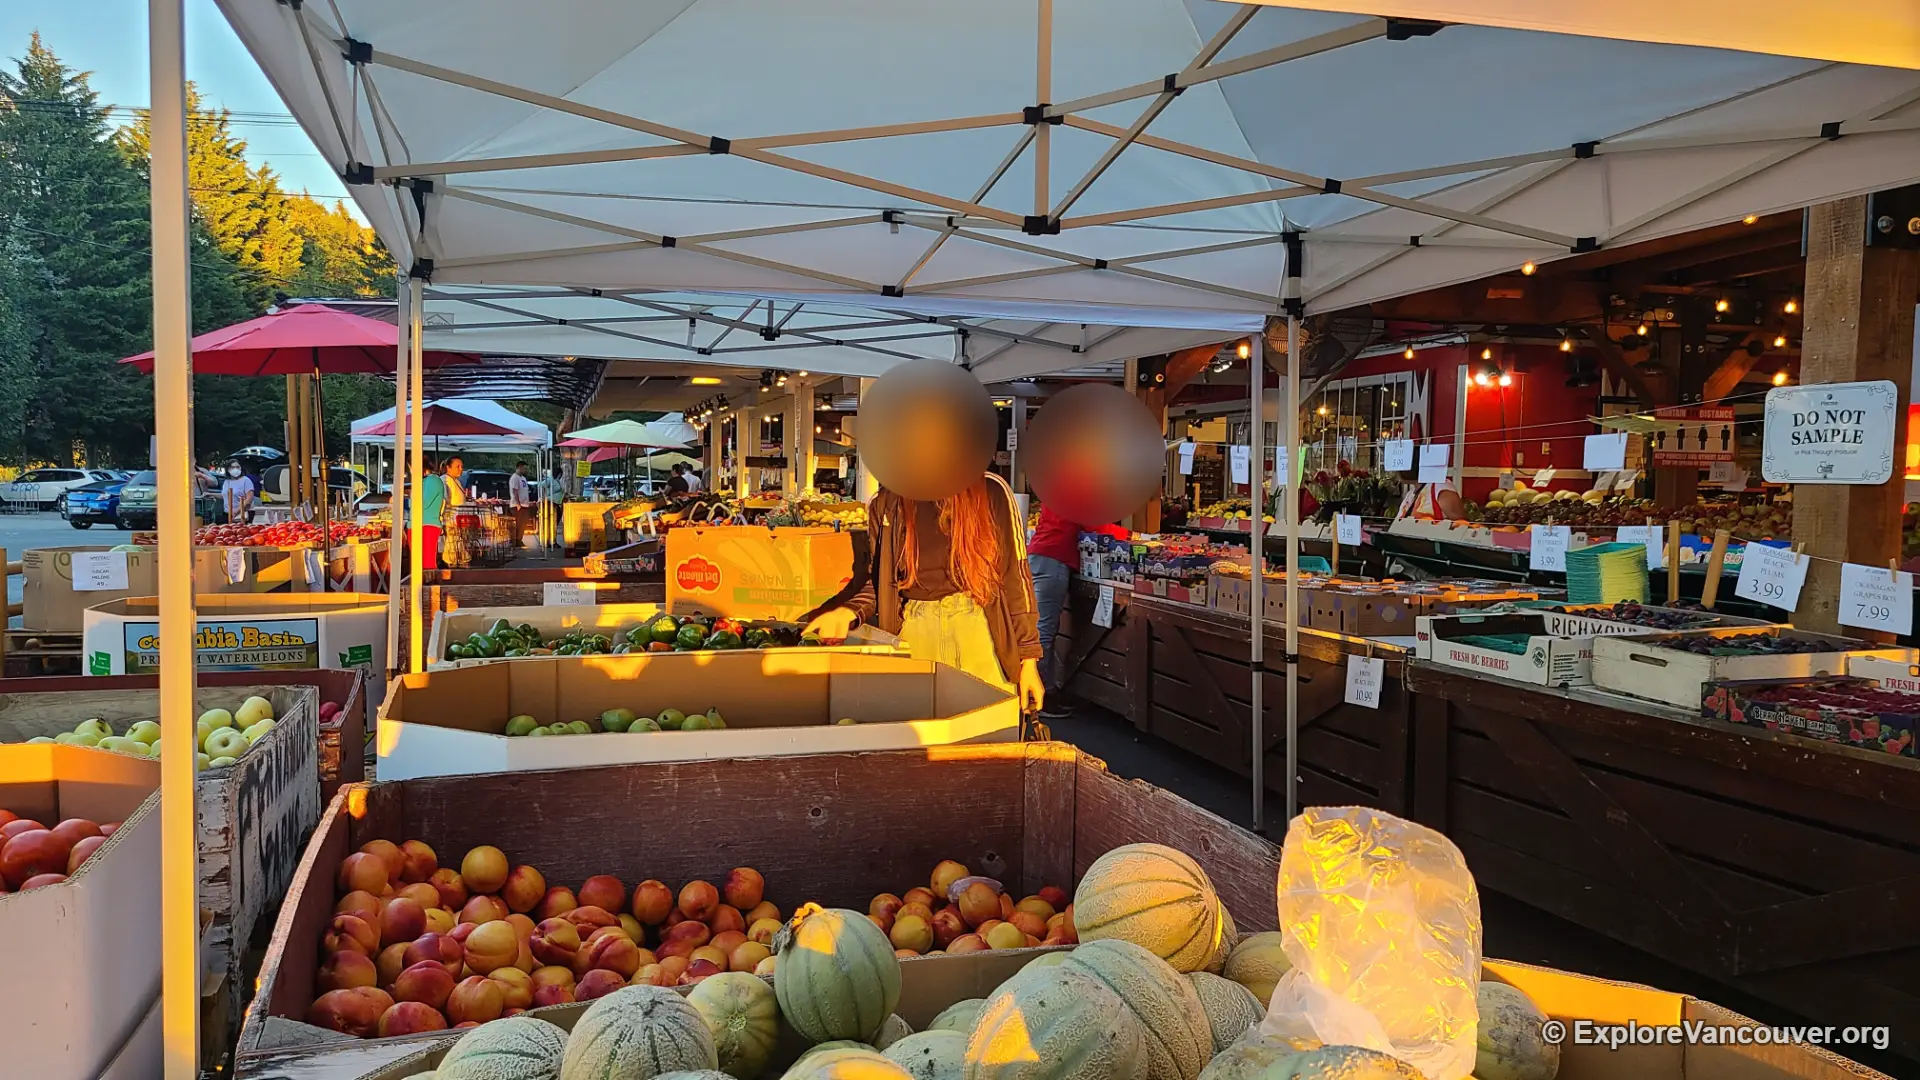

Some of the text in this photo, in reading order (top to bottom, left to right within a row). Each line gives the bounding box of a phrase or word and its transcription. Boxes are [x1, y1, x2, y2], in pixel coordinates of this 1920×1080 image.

[1699, 410, 1733, 418] DISTANCE
[1792, 409, 1866, 427] DO NOT
[1791, 428, 1864, 446] SAMPLE
[1759, 547, 1795, 562] OKANAGAN
[1763, 558, 1786, 569] BLACK
[678, 570, 719, 584] Del Monte
[1760, 567, 1785, 579] PLUMS
[1751, 579, 1784, 600] 3.99
[1855, 581, 1897, 593] OKANAGAN
[749, 590, 804, 604] Premium
[1853, 591, 1897, 603] GRAPES BOX
[1856, 603, 1890, 621] 7.99
[138, 626, 305, 649] Combia Basin
[207, 651, 303, 664] WATERMELONS
[1449, 649, 1510, 671] FRESH BC BERRIES
[1578, 650, 1594, 659] FRE
[1885, 677, 1915, 691] FRESH
[1356, 689, 1373, 702] 10.99
[1752, 706, 1777, 722] BERRY
[1776, 711, 1806, 728] HAVEN
